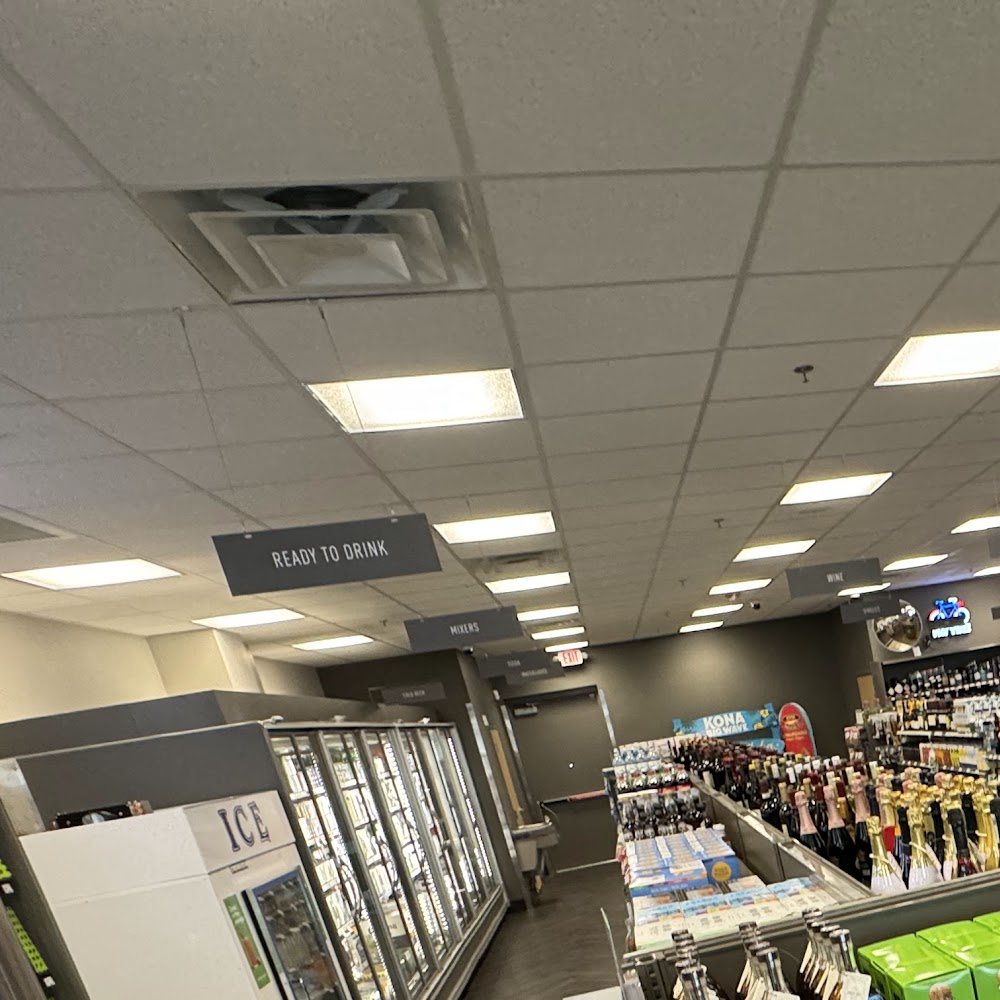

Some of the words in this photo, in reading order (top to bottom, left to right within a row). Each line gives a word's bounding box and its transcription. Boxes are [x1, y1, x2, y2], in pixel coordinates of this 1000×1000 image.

[272, 548, 317, 568] READY
[320, 545, 340, 563] TO
[343, 540, 388, 560] DRINK
[827, 572, 844, 583] WINE
[450, 622, 480, 636] MIXERS
[563, 650, 579, 665] EXIT
[703, 712, 746, 730] KONA
[722, 723, 748, 734] WAVE
[218, 801, 271, 852] ICE
